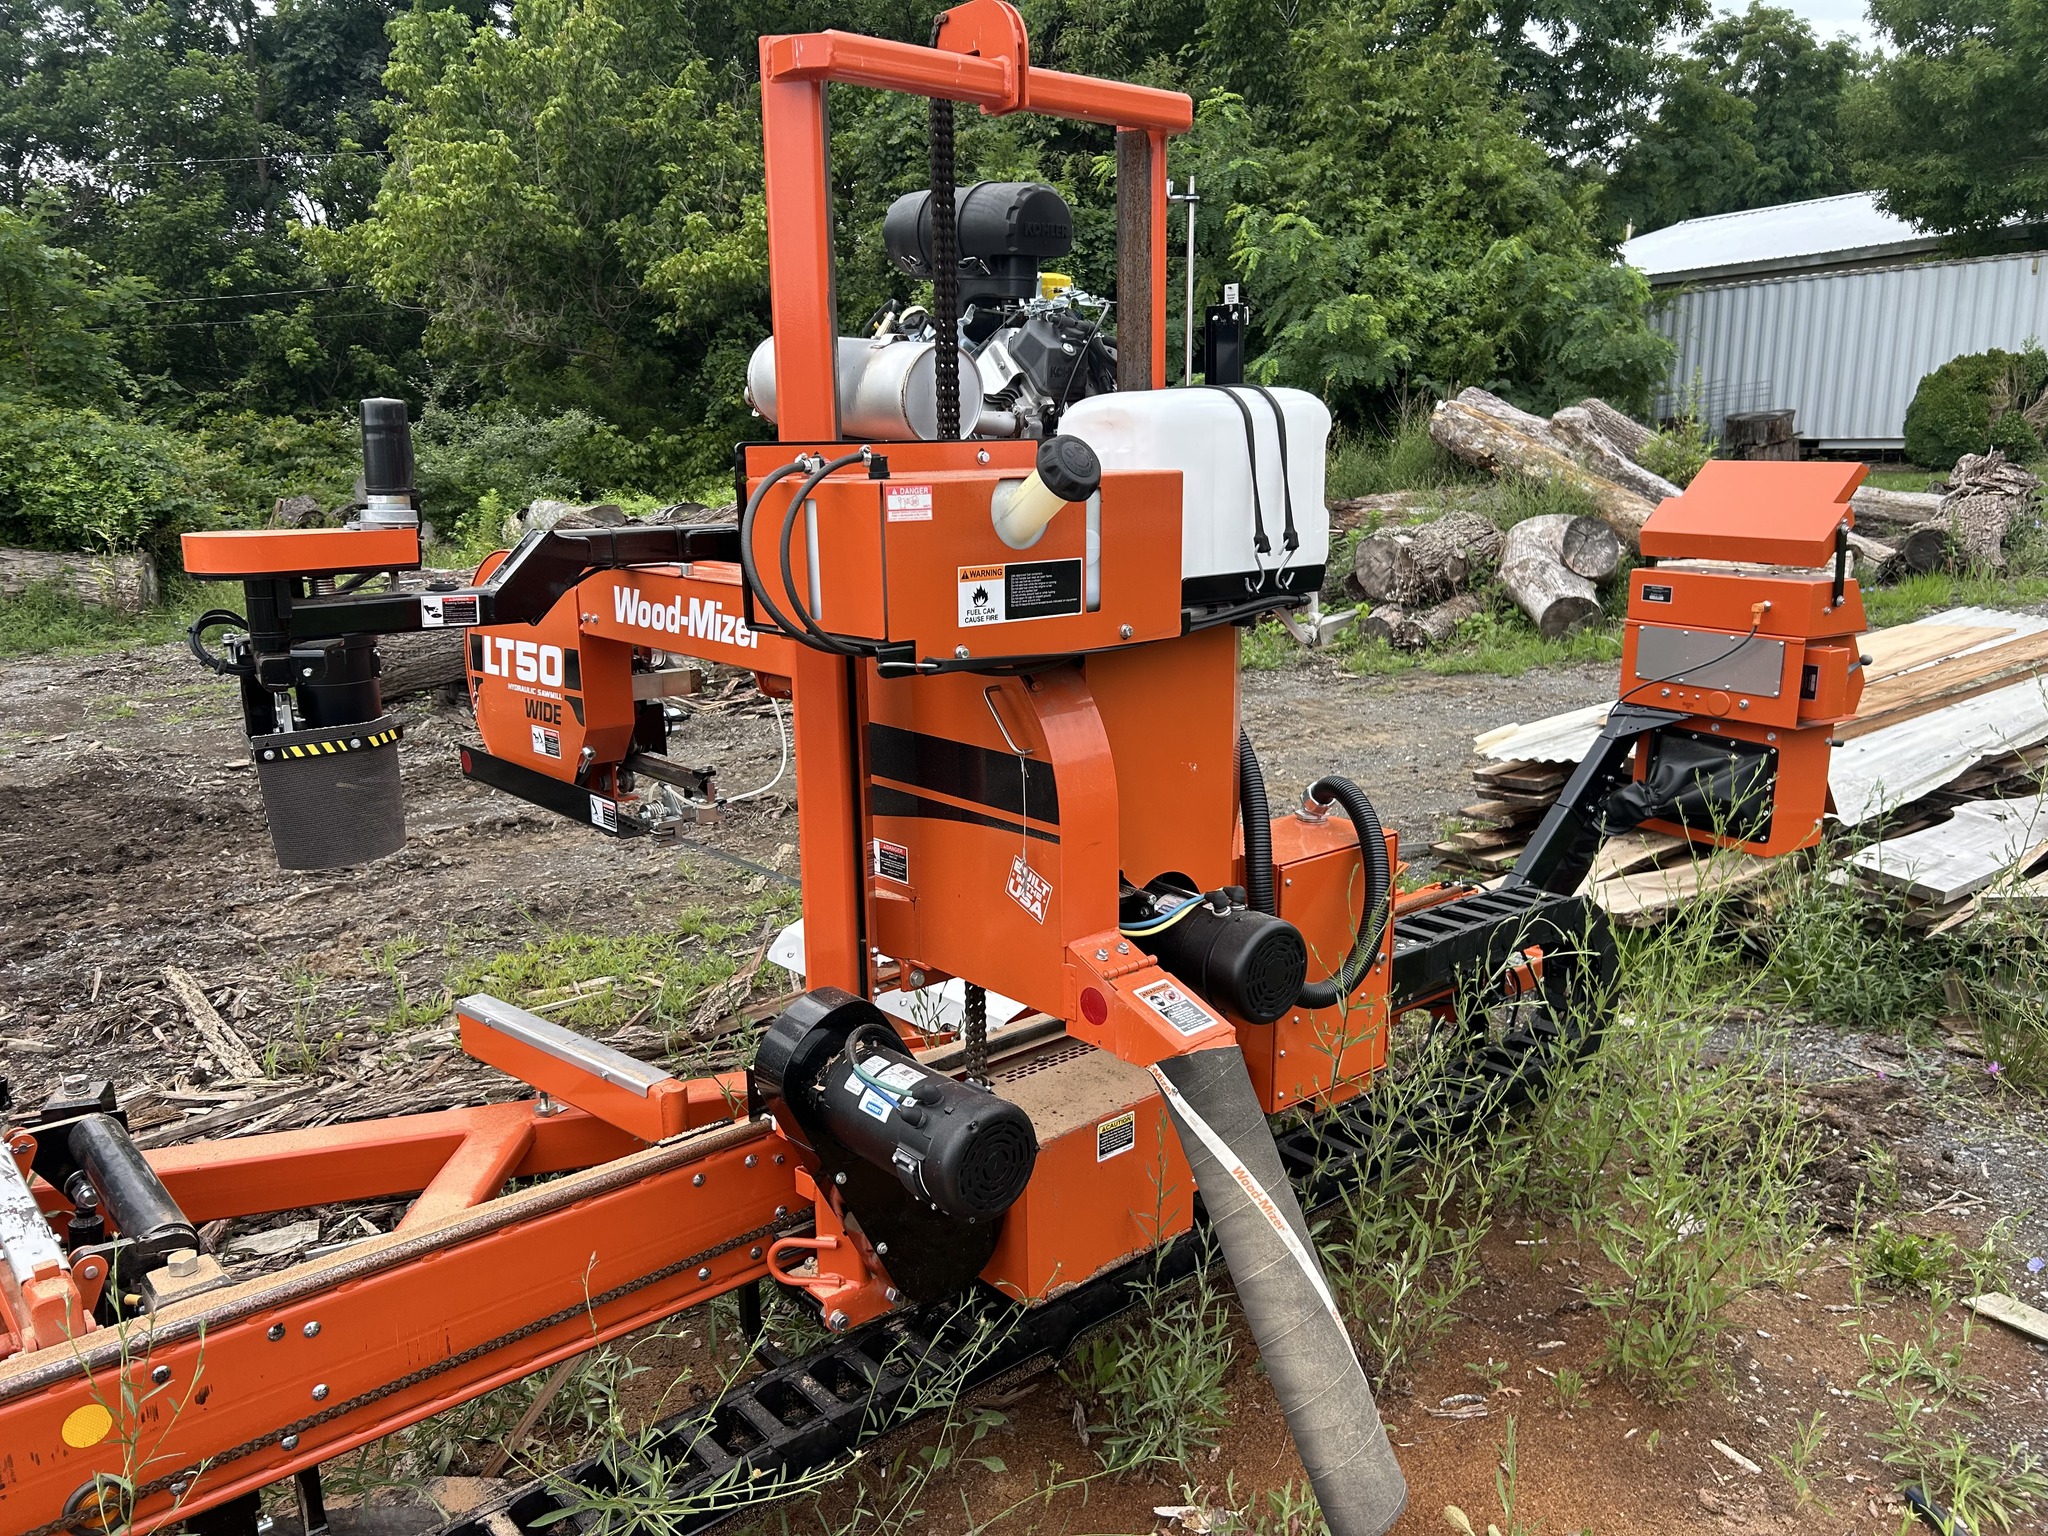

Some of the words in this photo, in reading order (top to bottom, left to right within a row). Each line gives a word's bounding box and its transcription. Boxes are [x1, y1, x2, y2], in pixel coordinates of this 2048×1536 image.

[1024, 222, 1068, 239] KOHLER
[900, 486, 929, 495] DANGER
[969, 568, 1003, 578] WARNING
[964, 615, 985, 624] CAUSE
[966, 608, 981, 616] FUEL
[483, 635, 563, 687] LT50
[507, 682, 537, 695] HYDRAULIC
[537, 689, 563, 700] SAWMILL
[524, 698, 561, 725] WIDE
[1008, 877, 1043, 921] USA
[1026, 882, 1043, 901] THE
[1105, 1115, 1132, 1130] CAUTION
[1231, 1165, 1286, 1232] Wood-Mizer
